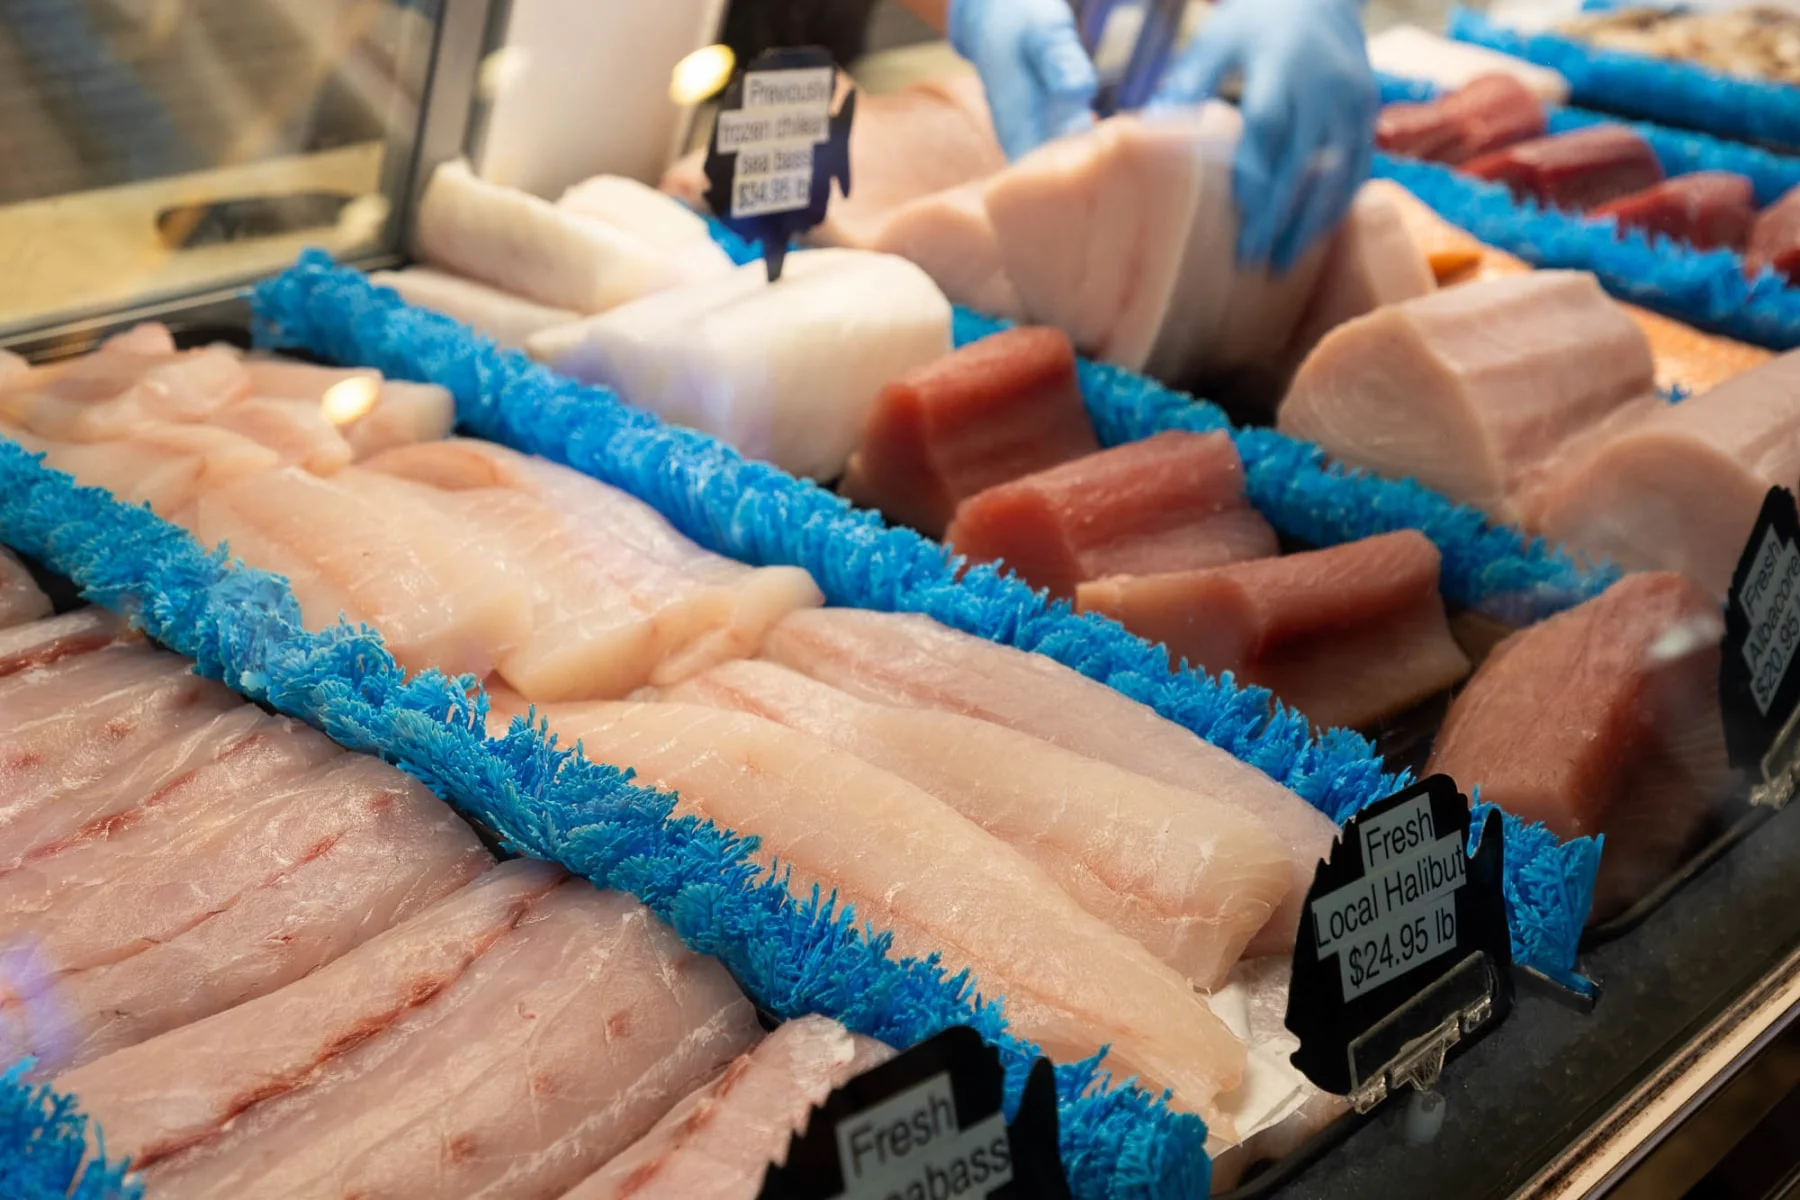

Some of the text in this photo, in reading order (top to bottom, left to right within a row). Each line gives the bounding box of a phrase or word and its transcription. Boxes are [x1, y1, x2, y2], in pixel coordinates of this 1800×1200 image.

[750, 79, 827, 105] Previously
[743, 153, 769, 176] sea
[1745, 540, 1782, 617] Fresh
[1751, 555, 1800, 672] Albacore
[1756, 607, 1799, 704] $20.95
[1366, 808, 1433, 867] Fresh
[1314, 844, 1465, 948] Local Halibut
[1350, 907, 1454, 989] $24.95 lb
[850, 1090, 954, 1179] Fresh
[885, 1138, 1010, 1200] abass
